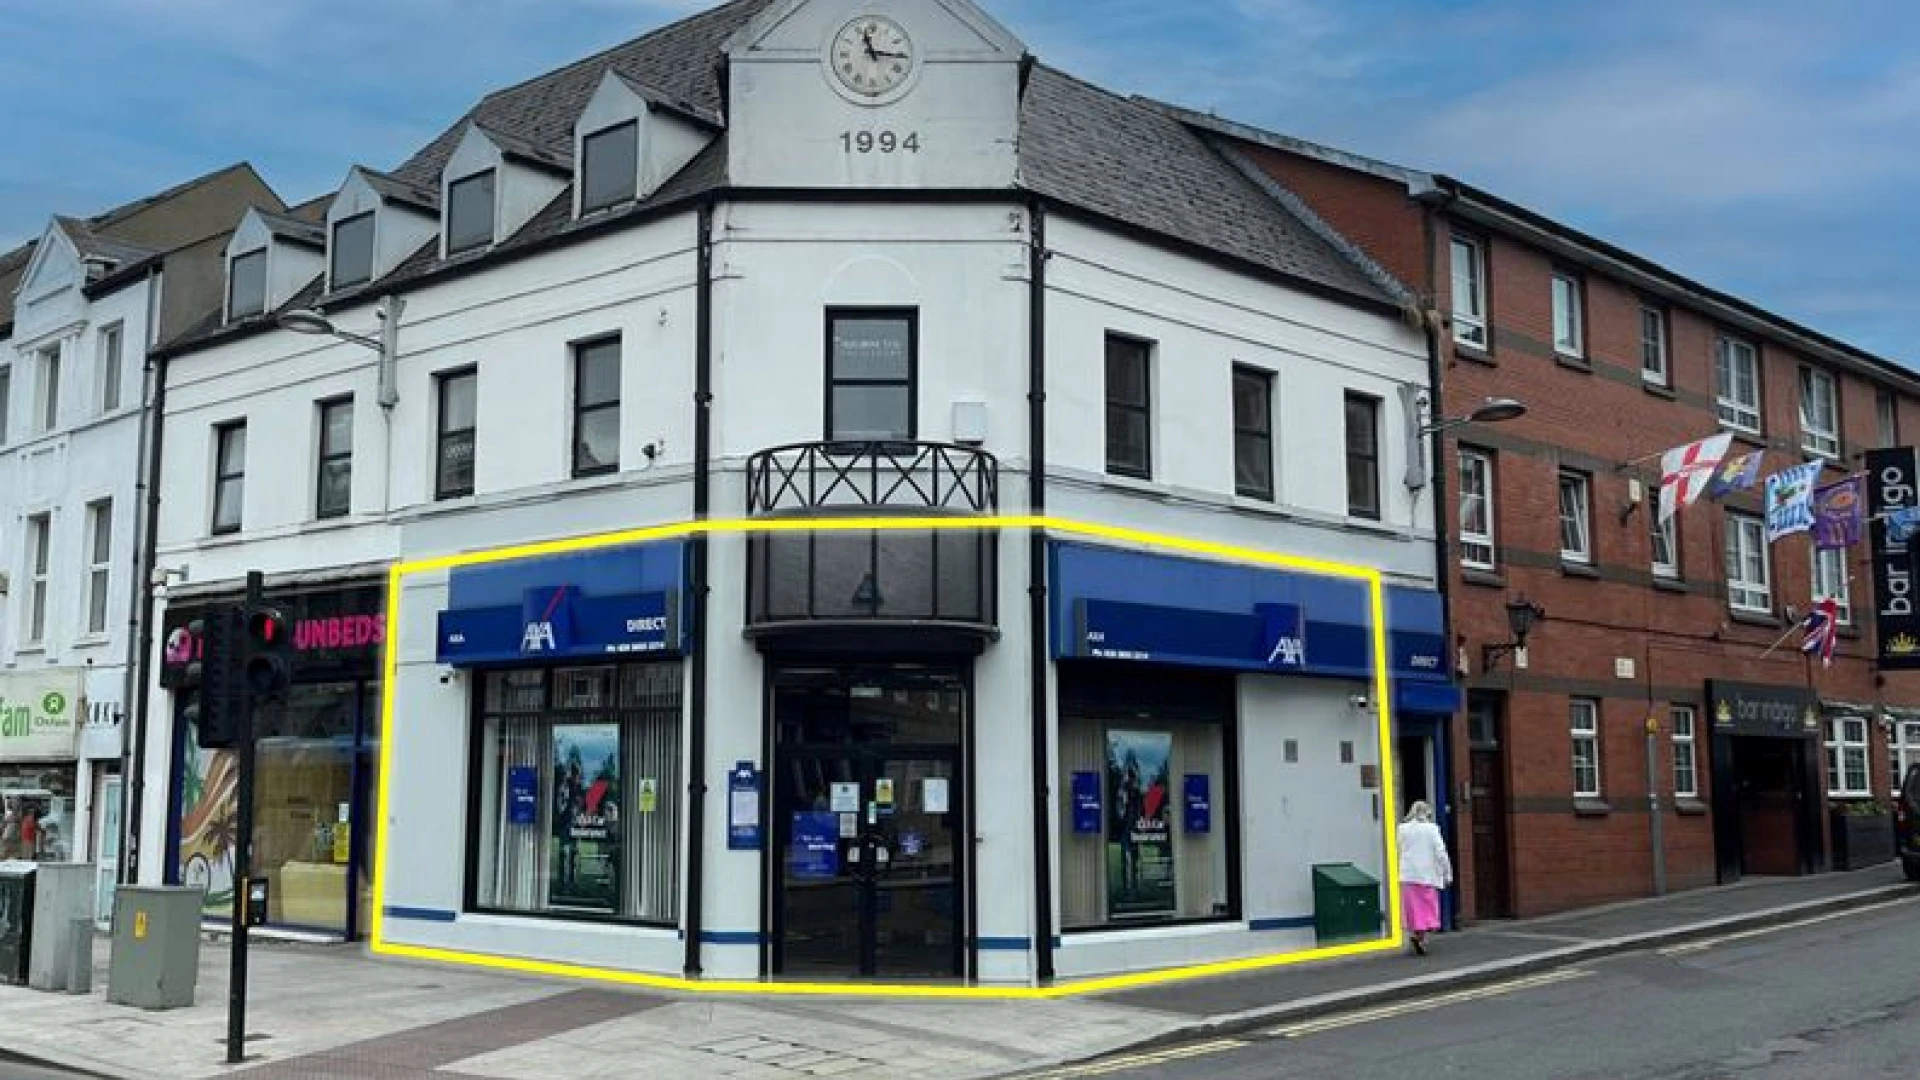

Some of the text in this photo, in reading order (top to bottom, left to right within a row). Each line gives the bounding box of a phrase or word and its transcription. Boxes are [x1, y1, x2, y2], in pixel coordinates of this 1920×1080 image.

[839, 130, 921, 154] 1994
[1881, 564, 1911, 616] bar
[521, 621, 555, 650] AXA
[626, 616, 667, 633] DIRECT
[1267, 637, 1305, 665] AXA
